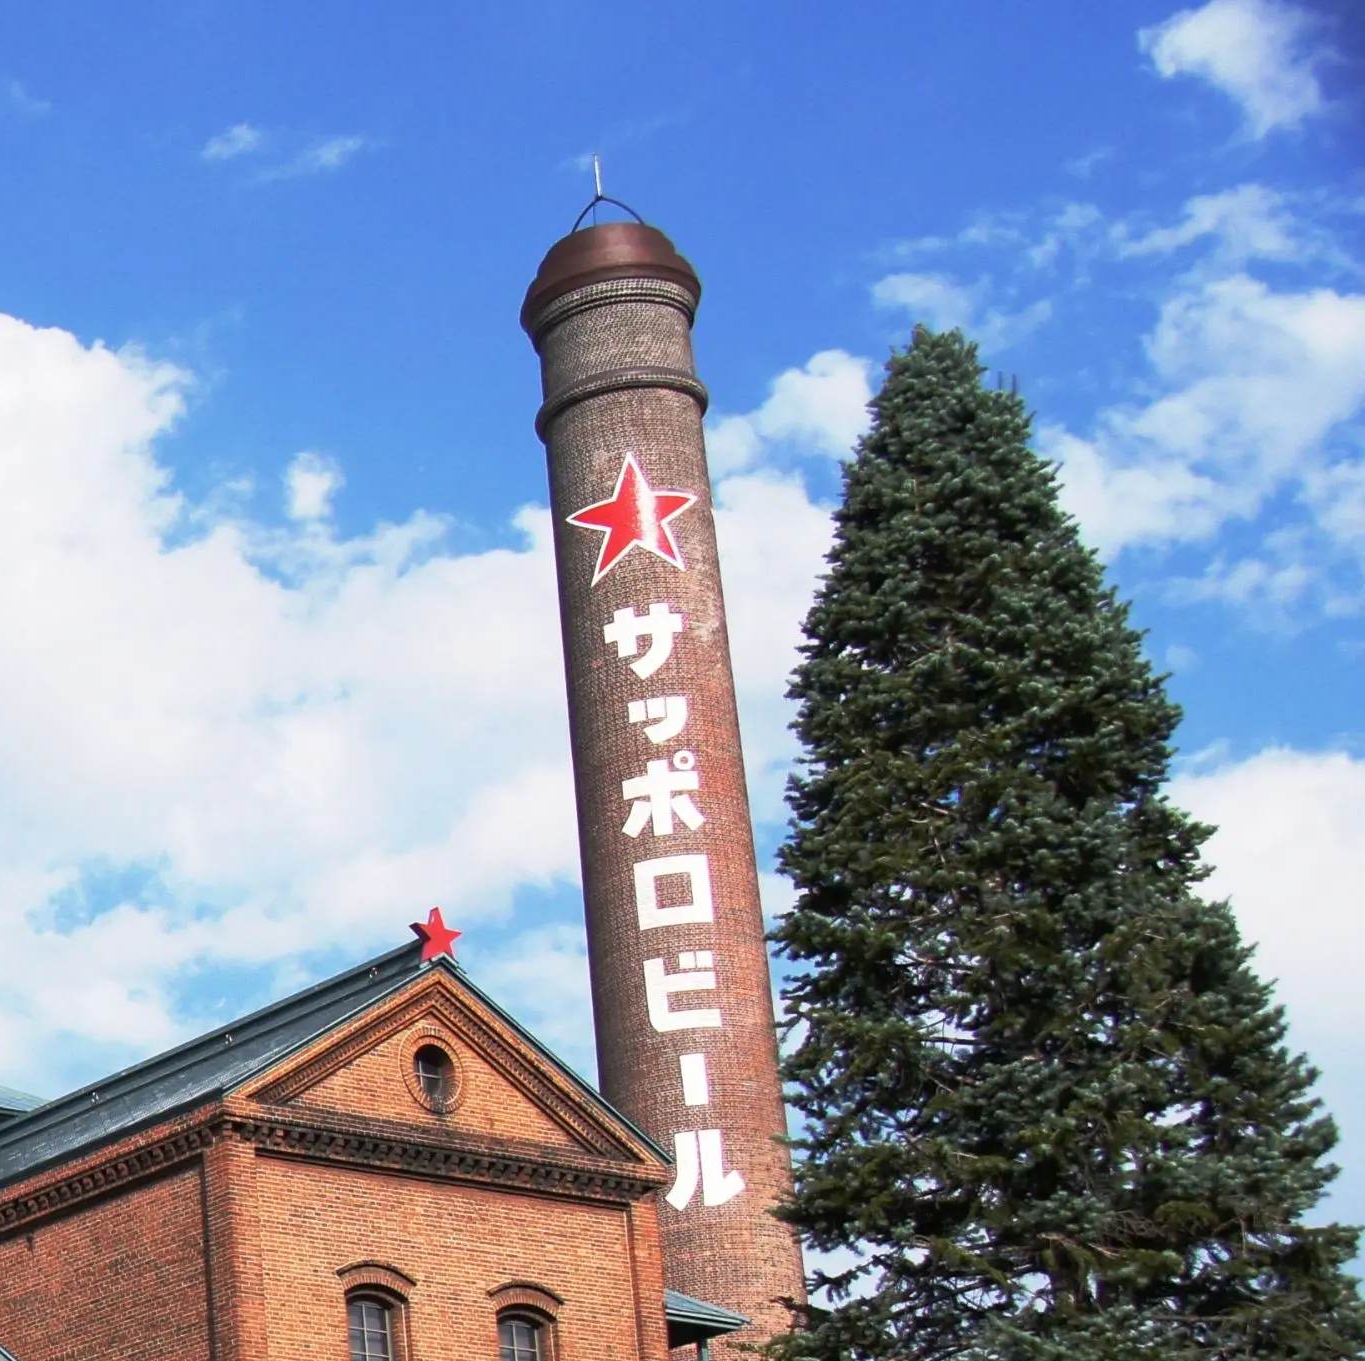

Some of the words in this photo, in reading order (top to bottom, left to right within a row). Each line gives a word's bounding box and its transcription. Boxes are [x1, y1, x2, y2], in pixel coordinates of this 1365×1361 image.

[603, 602, 746, 1211] サッポロビール
